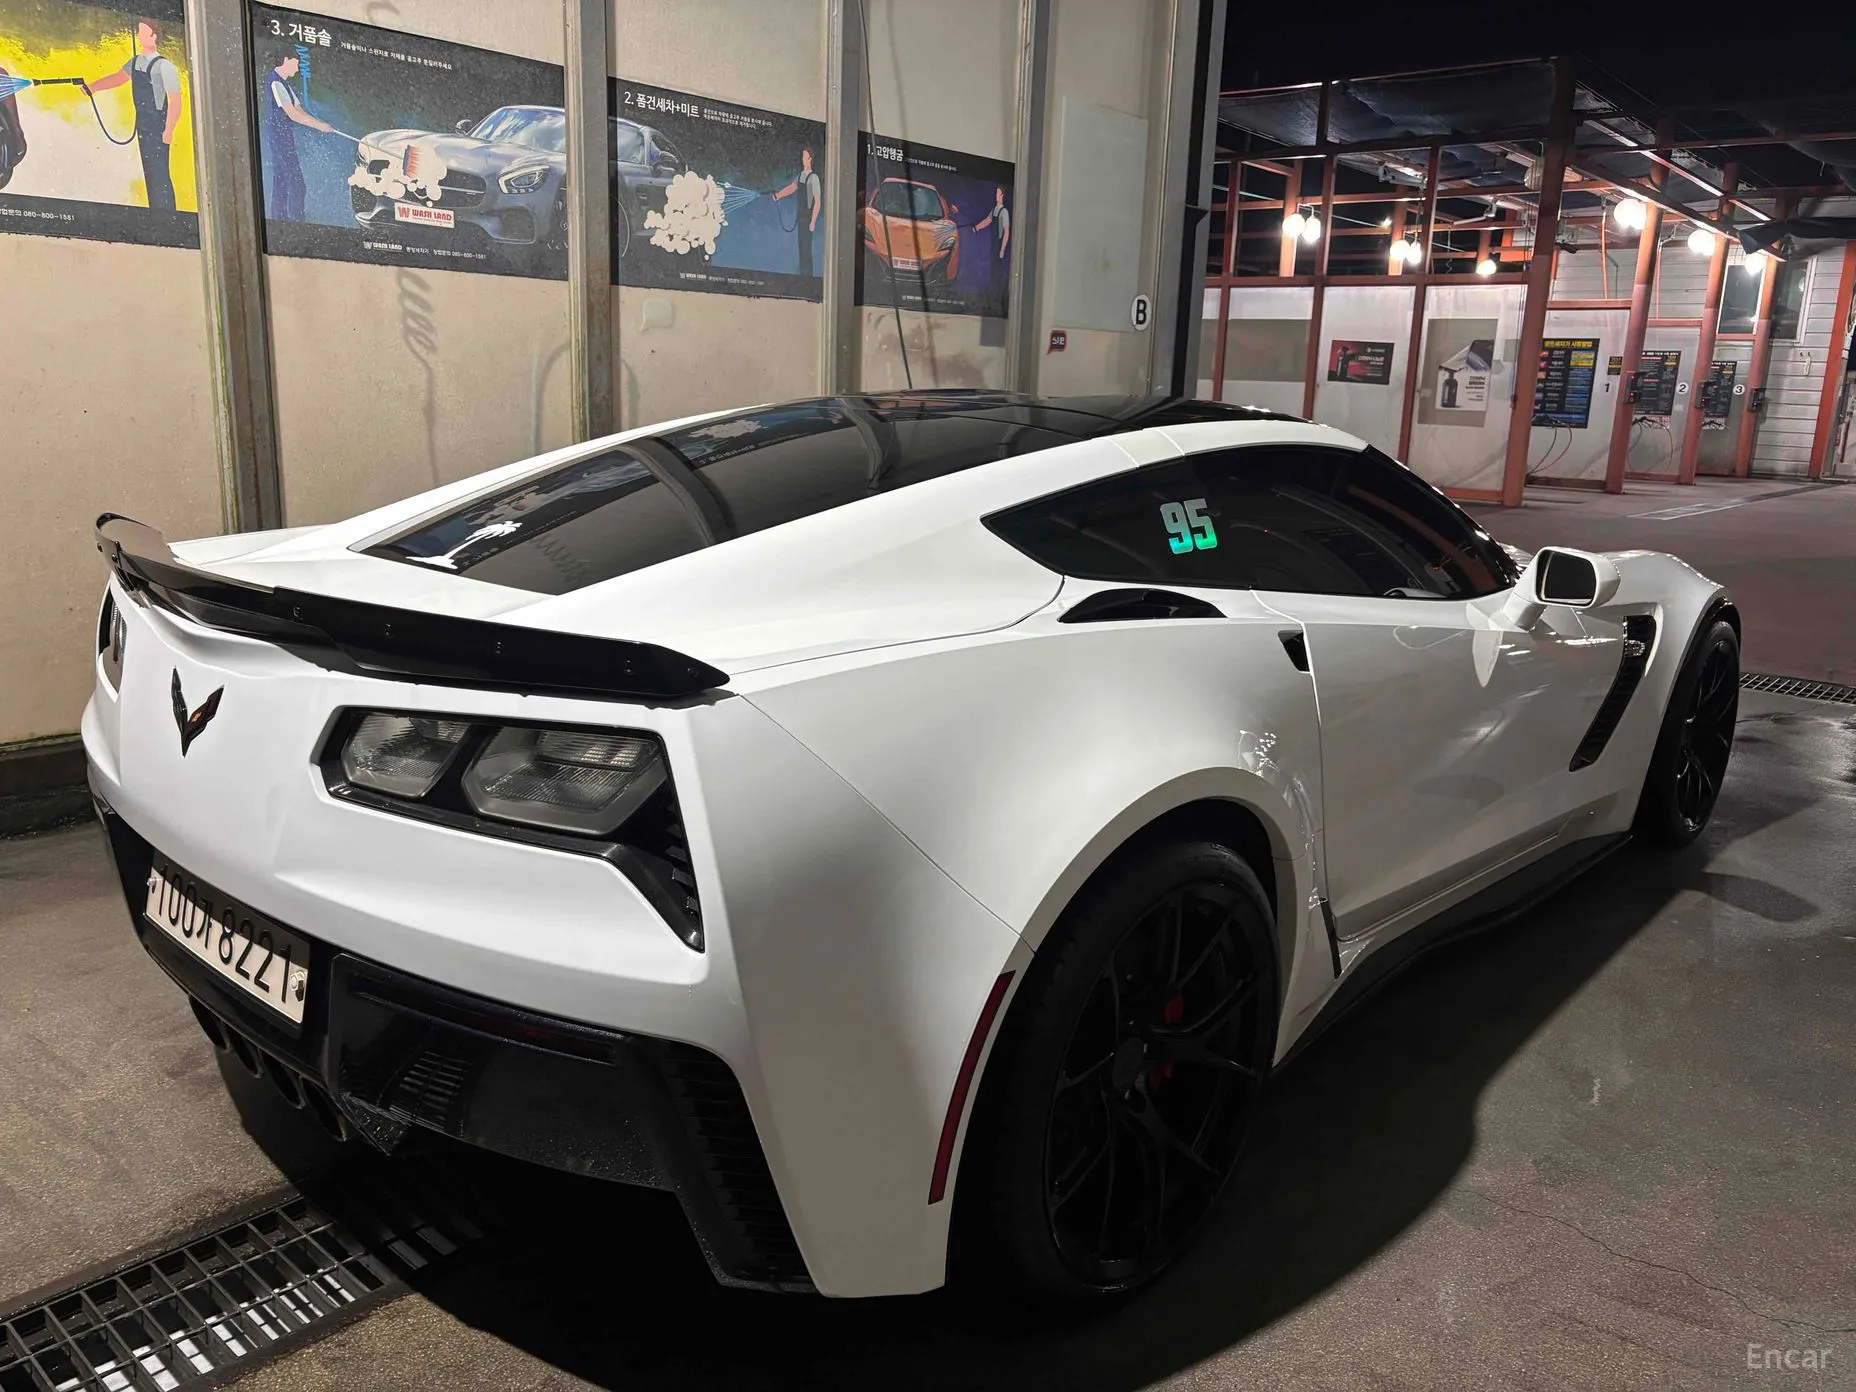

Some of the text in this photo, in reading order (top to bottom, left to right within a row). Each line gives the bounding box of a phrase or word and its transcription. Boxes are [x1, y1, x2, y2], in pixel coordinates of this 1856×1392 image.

[270, 19, 332, 47] 3. 거품솔
[624, 91, 634, 105] 2.
[636, 93, 700, 118] 폼건세차+미트
[867, 143, 874, 155] 1.
[0, 208, 21, 216] 업문의
[411, 210, 432, 219] WASH
[434, 212, 452, 221] LAND
[1136, 299, 1147, 325] B
[1604, 383, 1610, 393] 1
[1679, 384, 1687, 393] 2
[1735, 385, 1743, 394] 3
[1160, 498, 1217, 554] 95
[219, 907, 292, 1004] 8221
